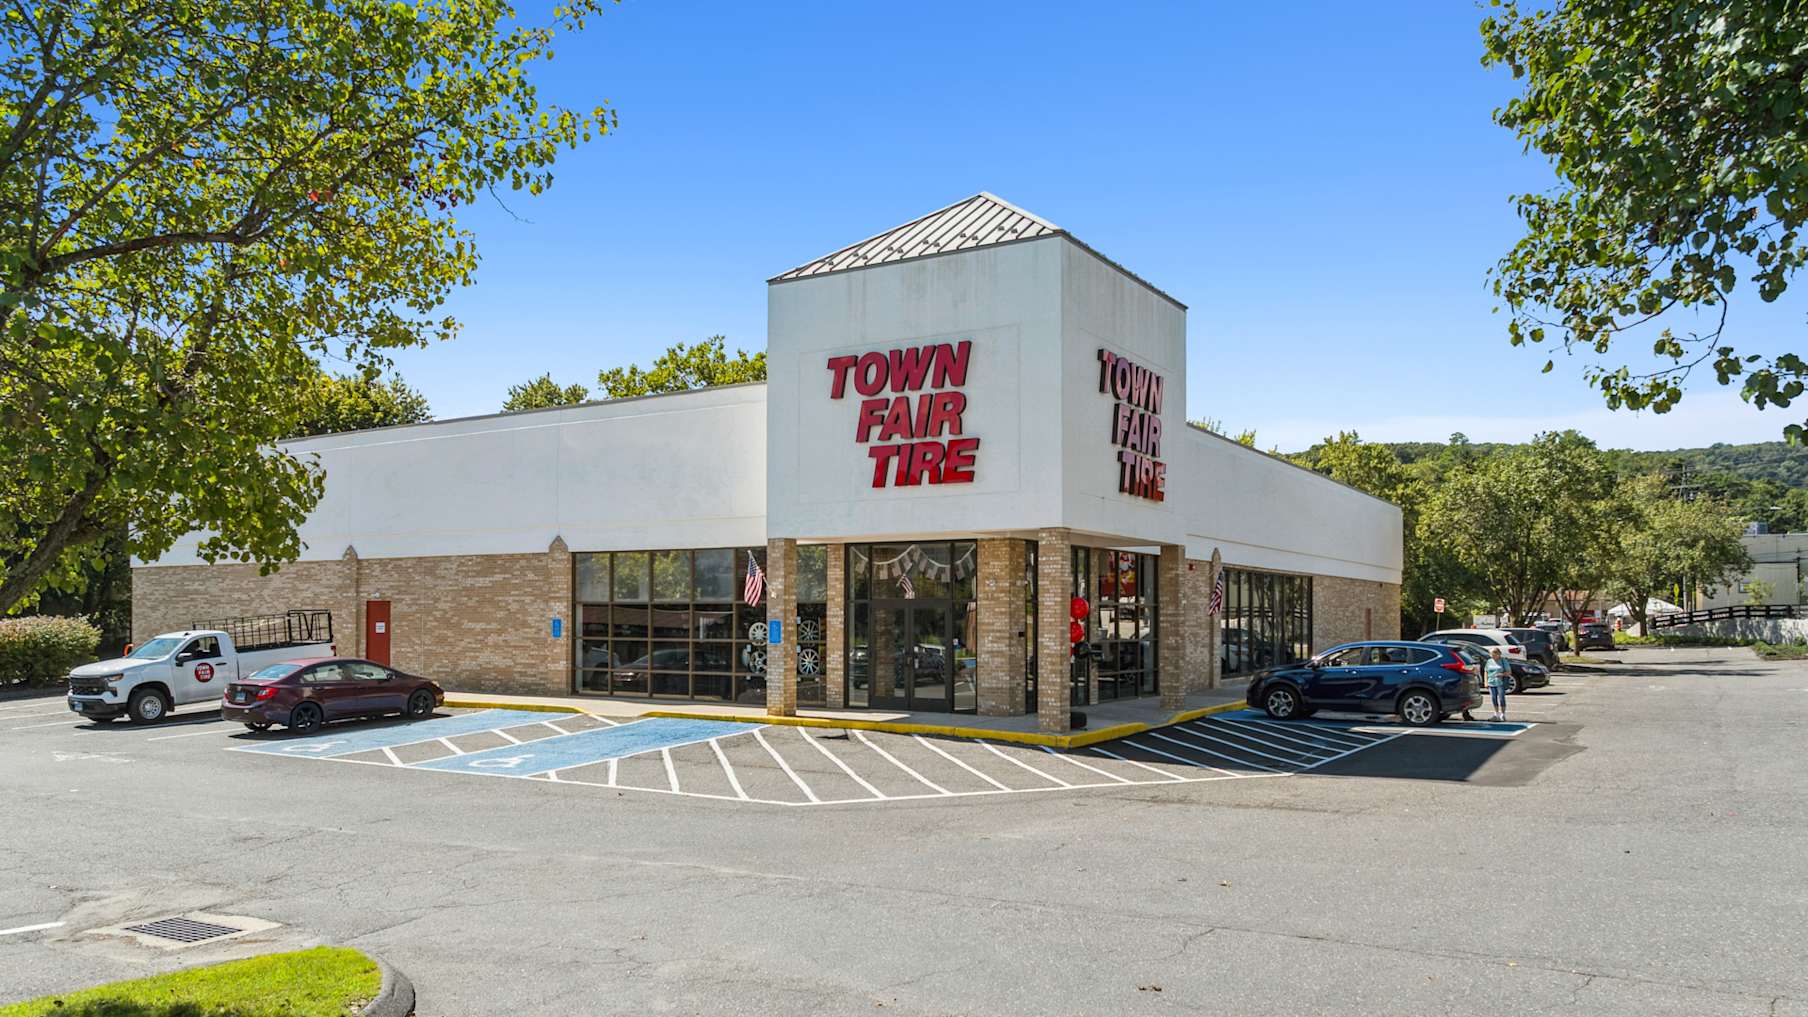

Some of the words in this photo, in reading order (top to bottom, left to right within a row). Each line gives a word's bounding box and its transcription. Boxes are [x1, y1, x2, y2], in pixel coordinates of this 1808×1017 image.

[827, 341, 972, 399] TOWN
[1098, 349, 1164, 415] TOWN
[856, 391, 967, 443] FAIR
[1112, 403, 1162, 458] FAIR
[868, 438, 981, 488] TIRE
[1118, 451, 1167, 502] TIRE
